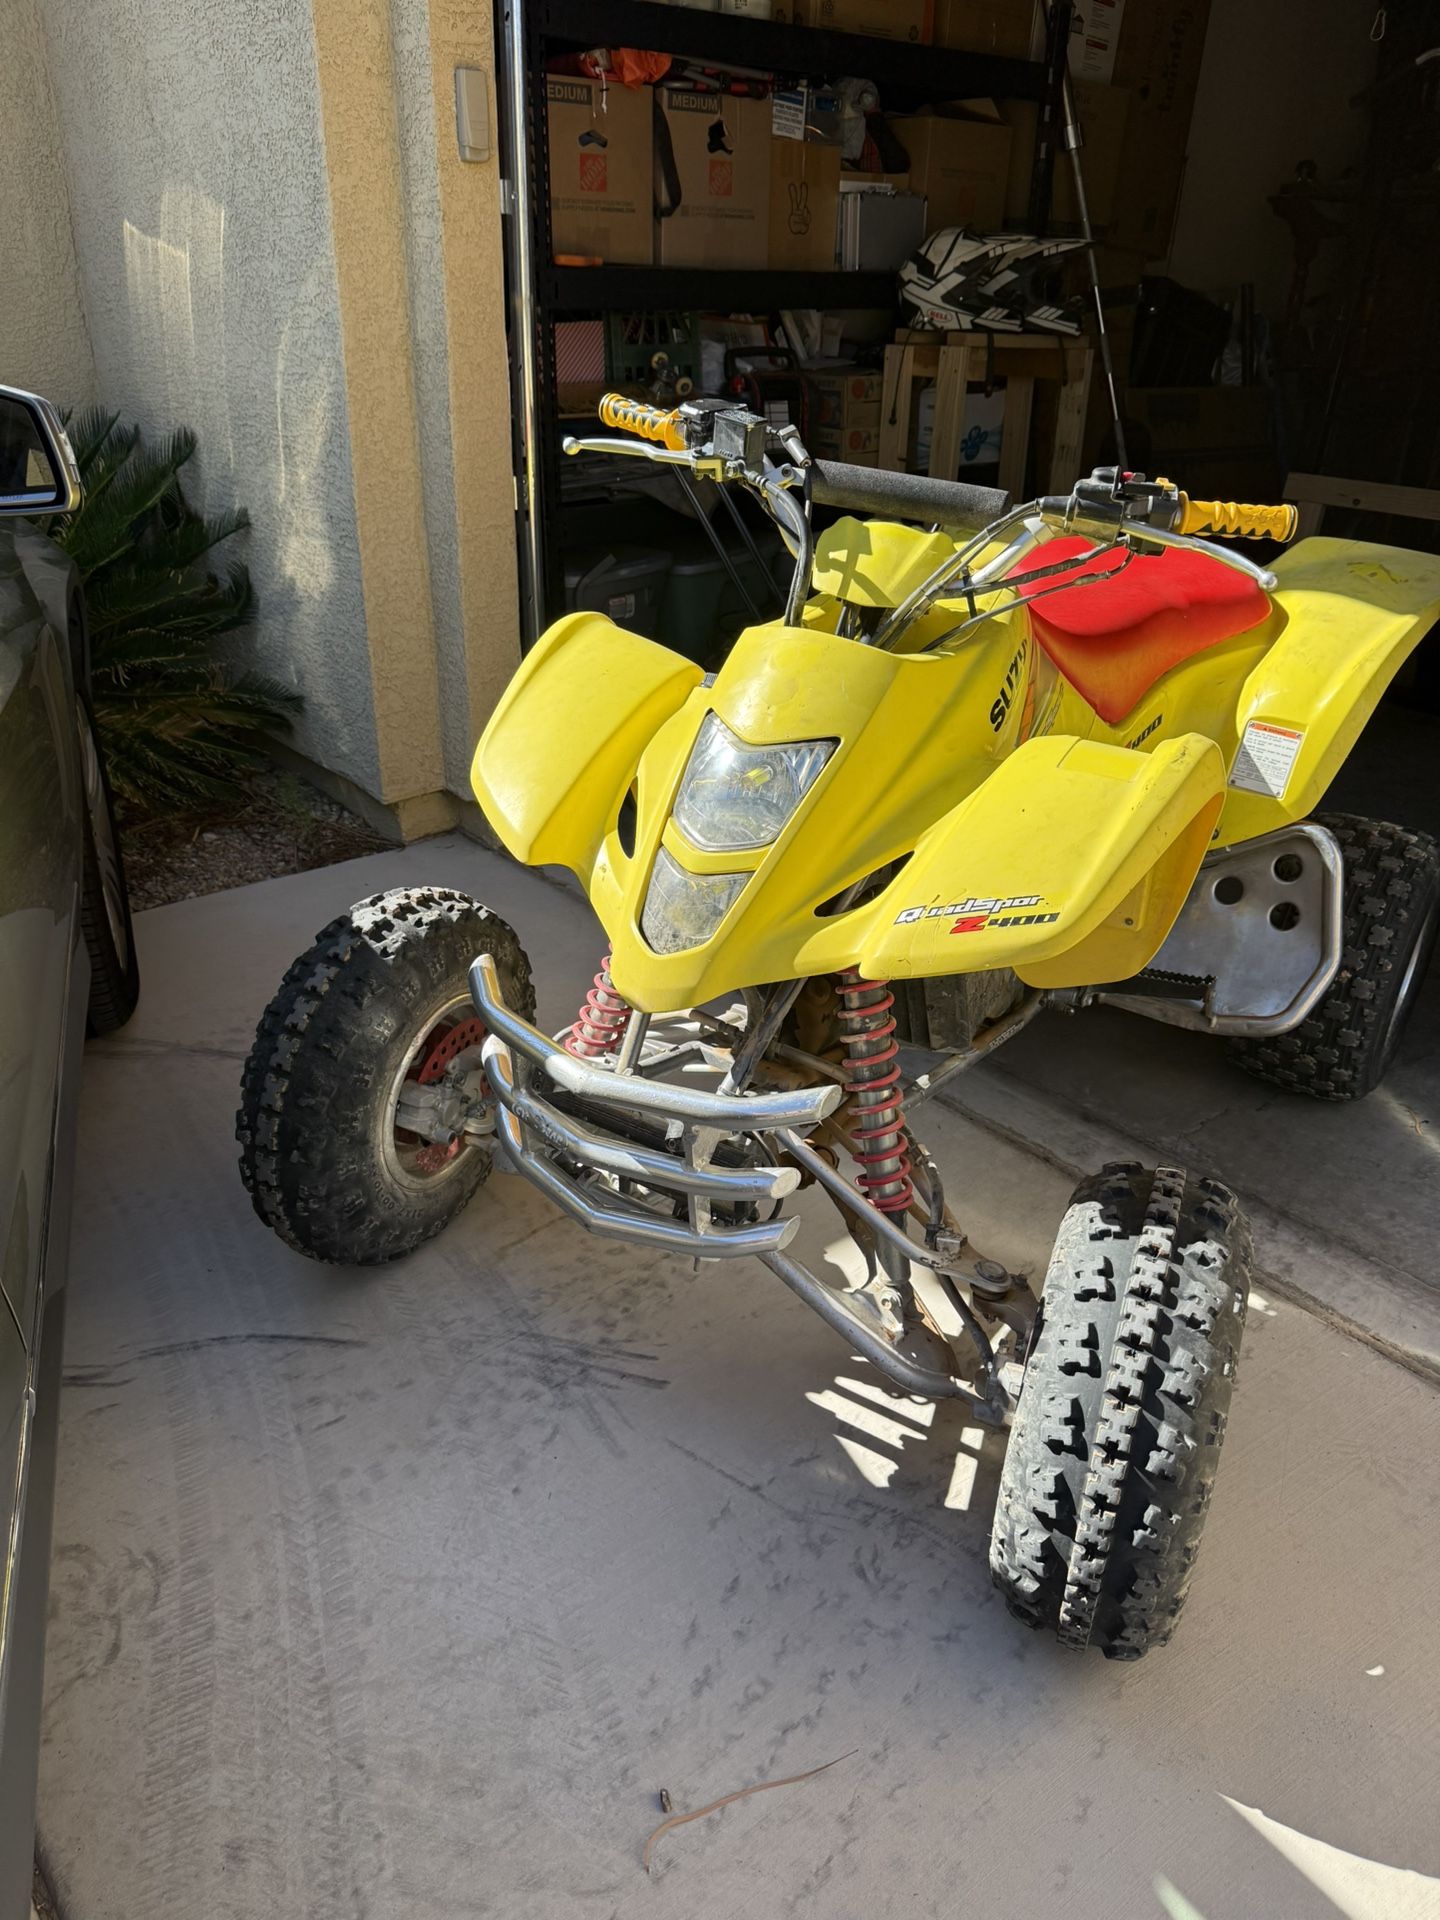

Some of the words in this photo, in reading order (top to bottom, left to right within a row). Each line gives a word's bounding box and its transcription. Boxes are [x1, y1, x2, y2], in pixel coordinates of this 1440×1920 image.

[547, 84, 588, 102] EDIUM
[672, 94, 718, 111] MEDIUM
[950, 911, 1061, 935] Z400
